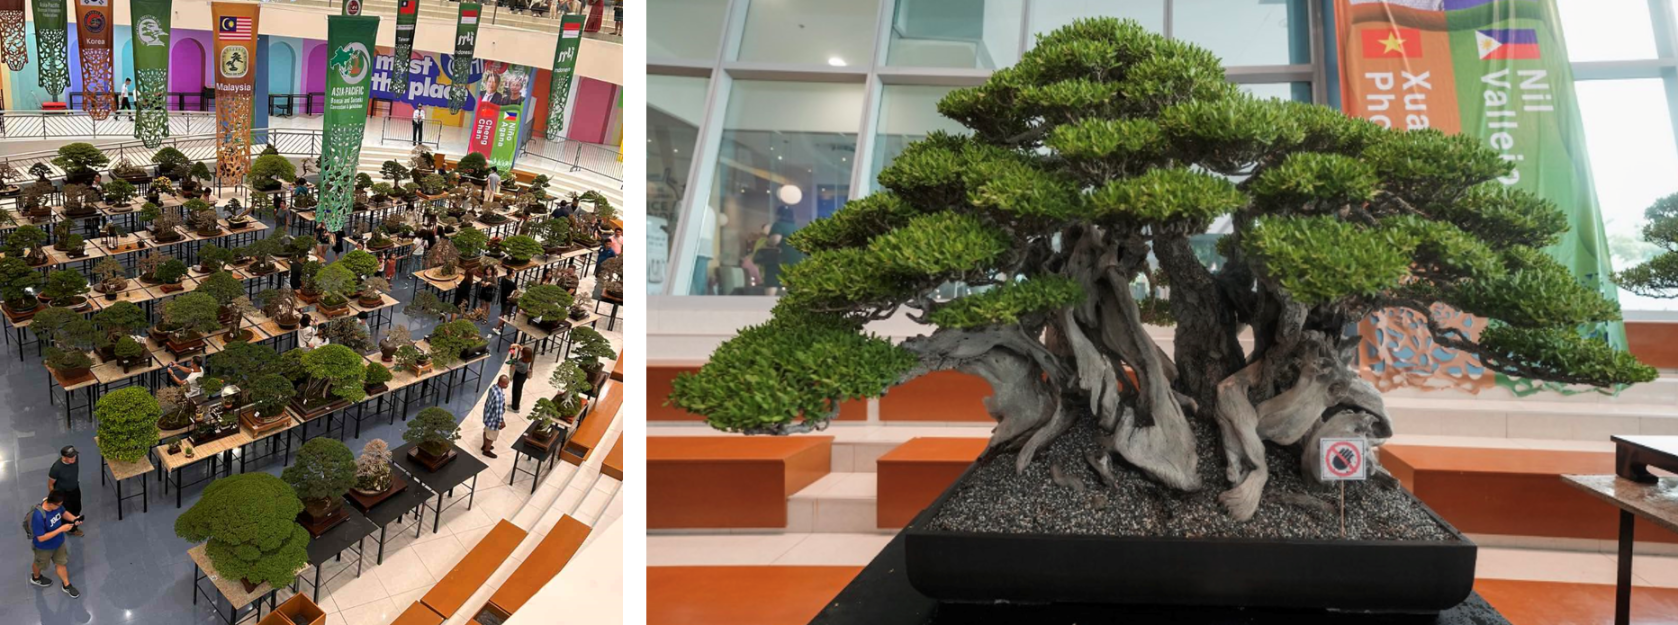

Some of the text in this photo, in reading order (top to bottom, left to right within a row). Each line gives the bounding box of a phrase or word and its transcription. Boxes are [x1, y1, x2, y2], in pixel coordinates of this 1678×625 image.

[376, 55, 433, 75] mst
[216, 82, 251, 93] Malaysia
[331, 86, 364, 96] ASIA-PACIFIC
[1517, 69, 1554, 112] Nil
[475, 118, 485, 139] Chan
[480, 119, 493, 145] Cheng
[498, 121, 508, 147] Agana
[506, 122, 516, 141] Niño
